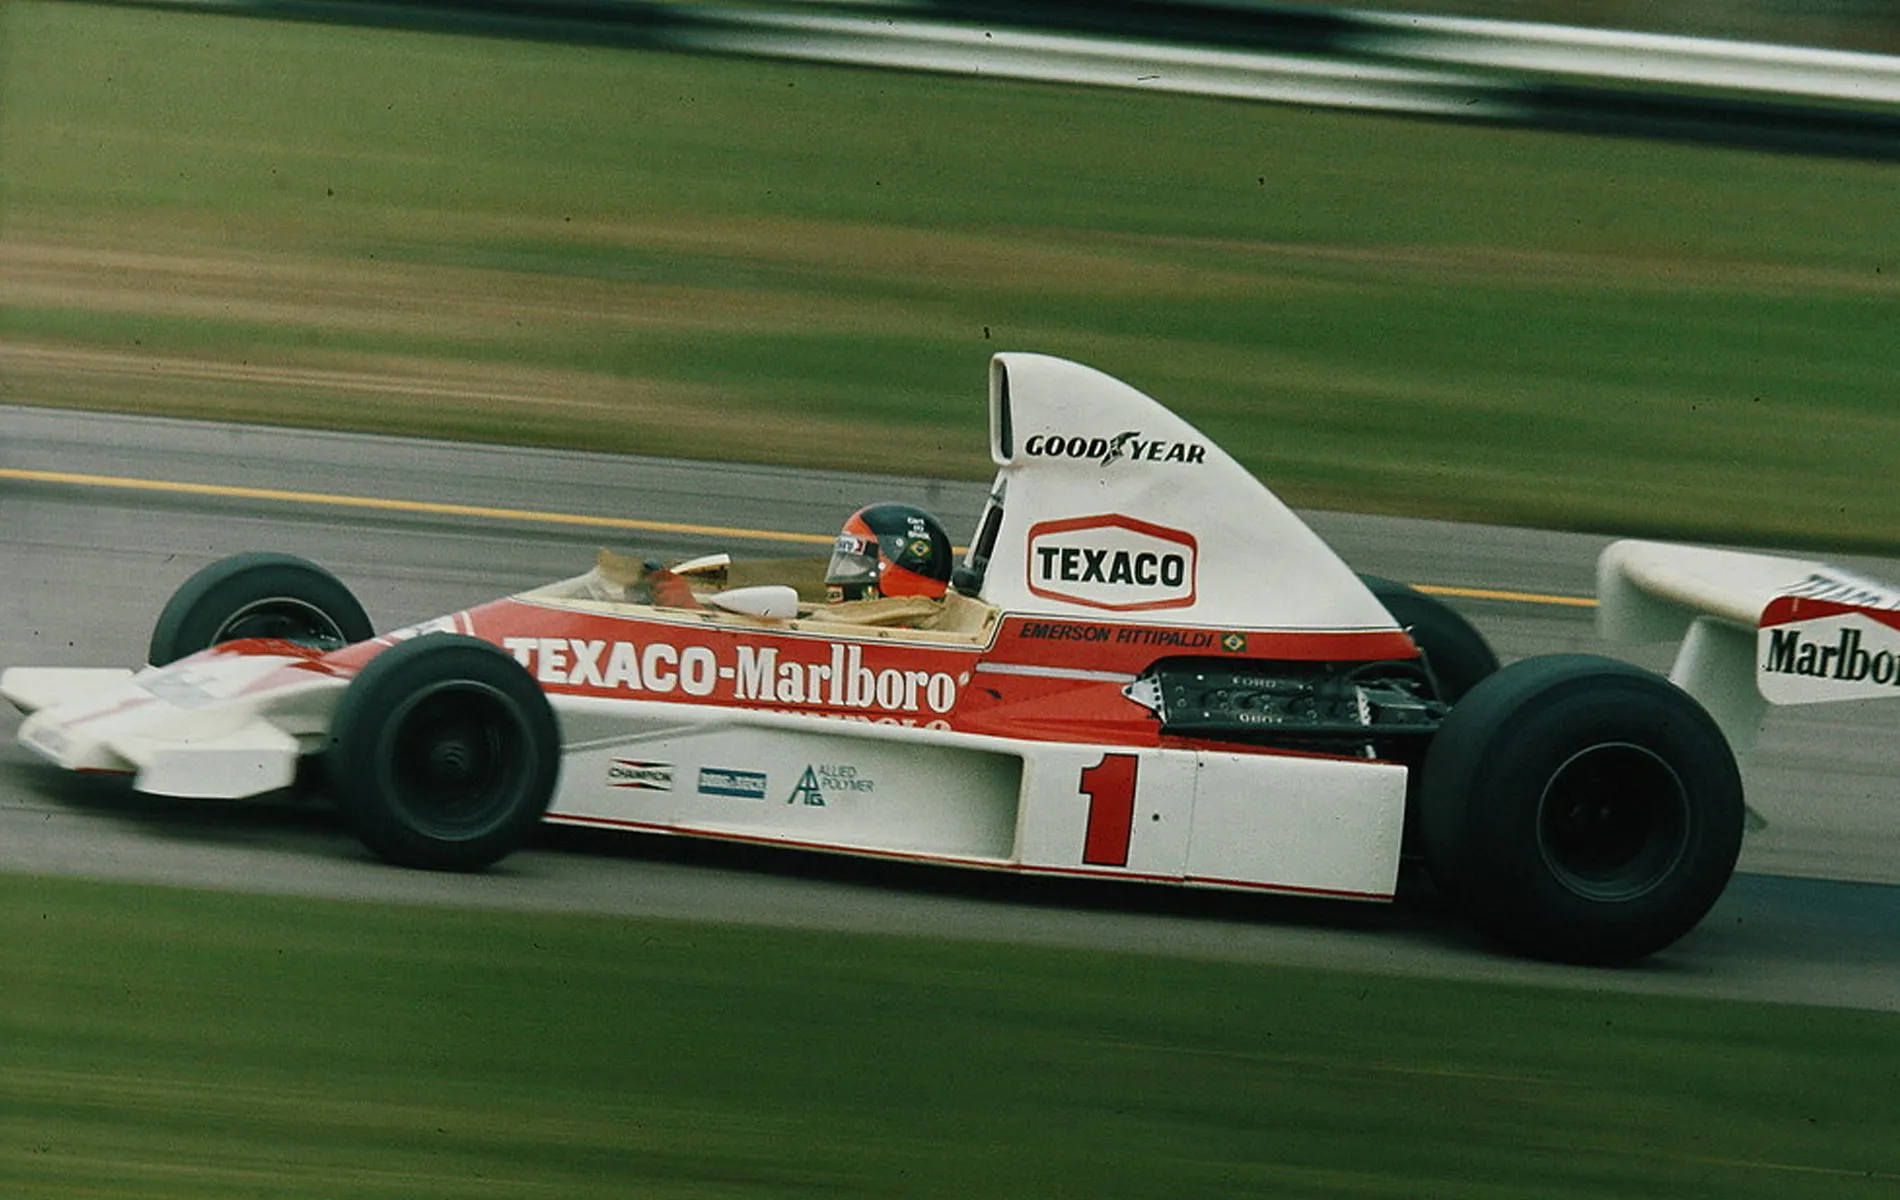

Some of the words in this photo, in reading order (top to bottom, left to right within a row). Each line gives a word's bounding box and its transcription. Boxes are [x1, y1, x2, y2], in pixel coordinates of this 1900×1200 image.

[1037, 547, 1185, 588] TEXACO
[1019, 622, 1111, 642] EMERSON
[1116, 628, 1214, 648] FITTIPALDI
[608, 767, 673, 782] CHAMPION
[820, 763, 858, 779] ALLIED
[1079, 753, 1139, 867] 1
